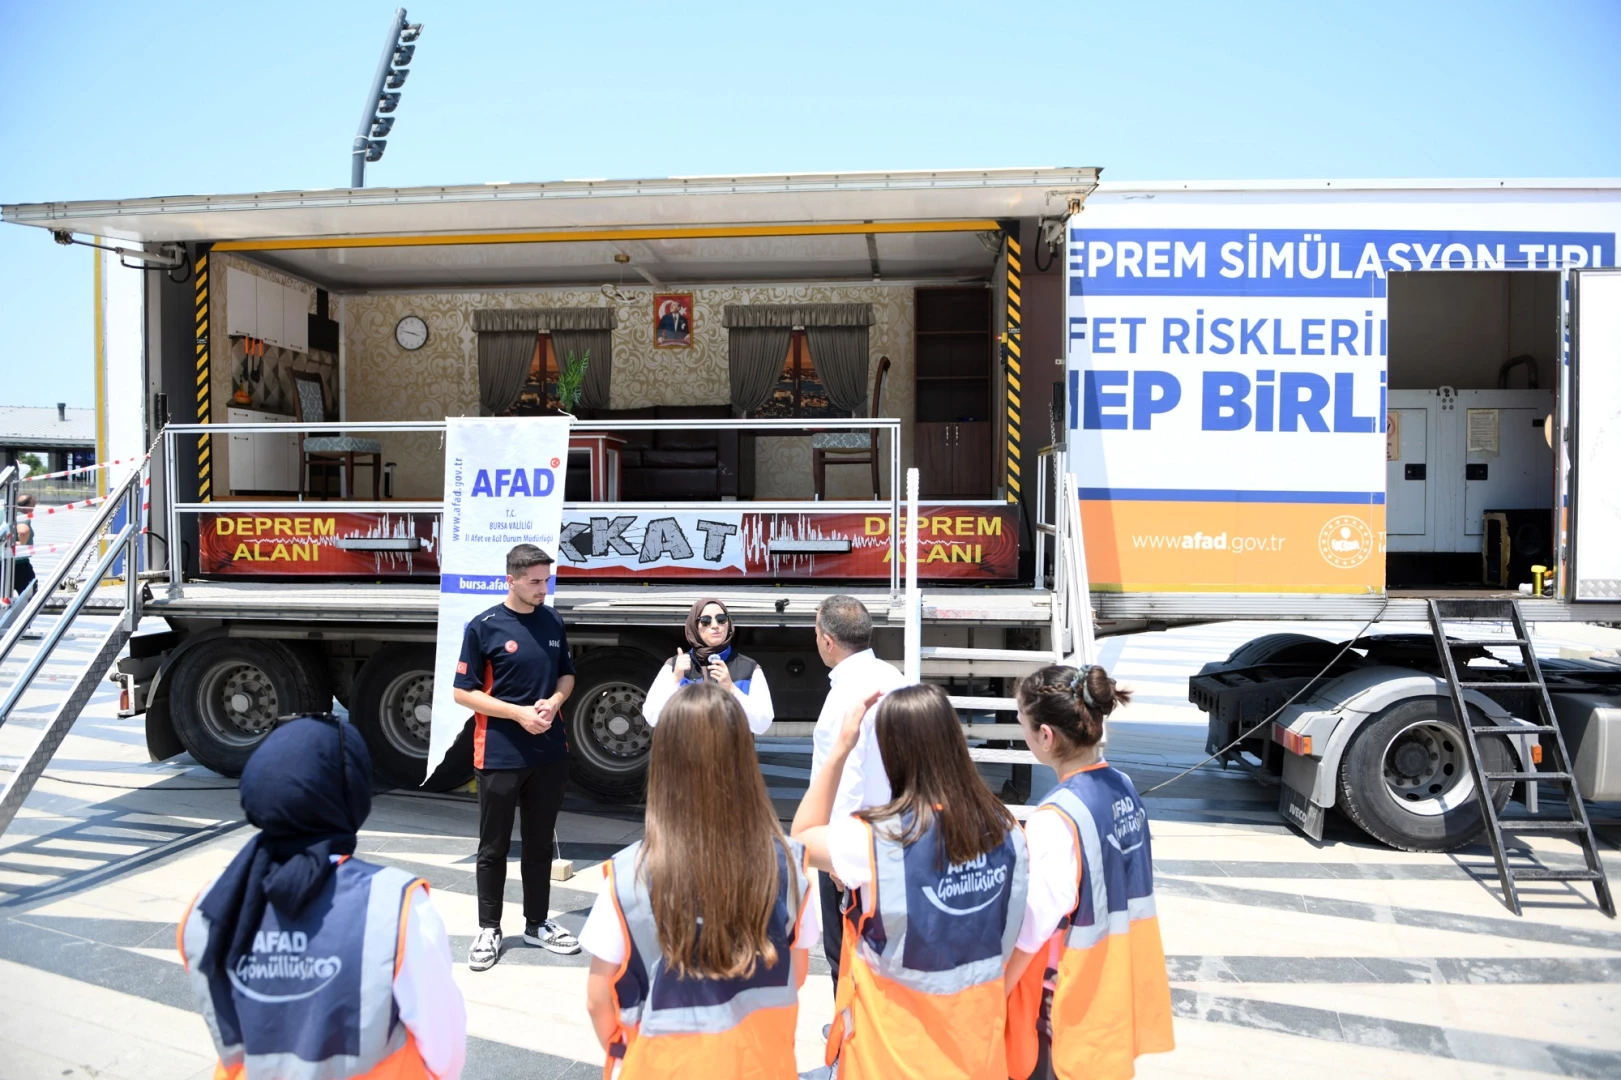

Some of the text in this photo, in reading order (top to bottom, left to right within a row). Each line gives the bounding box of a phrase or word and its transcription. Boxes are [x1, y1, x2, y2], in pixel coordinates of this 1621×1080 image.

[1219, 233, 1505, 279] SİMÜLASYON
[1162, 309, 1386, 356] RİSKLERİ
[470, 468, 555, 498] AFAD
[451, 457, 465, 542] www.afad.gov.tr
[505, 509, 517, 518] T.C.
[216, 517, 336, 536] DEPREM
[489, 522, 508, 530] BURSA
[470, 534, 484, 542] Afet
[503, 535, 523, 543] Durum
[232, 543, 319, 562] ALANI
[882, 544, 982, 563] AANI
[1288, 803, 1307, 823] IVECO
[937, 868, 995, 902] Gönüllüsü
[252, 931, 308, 953] AFAD
[236, 954, 316, 981] Gönüllüsü
